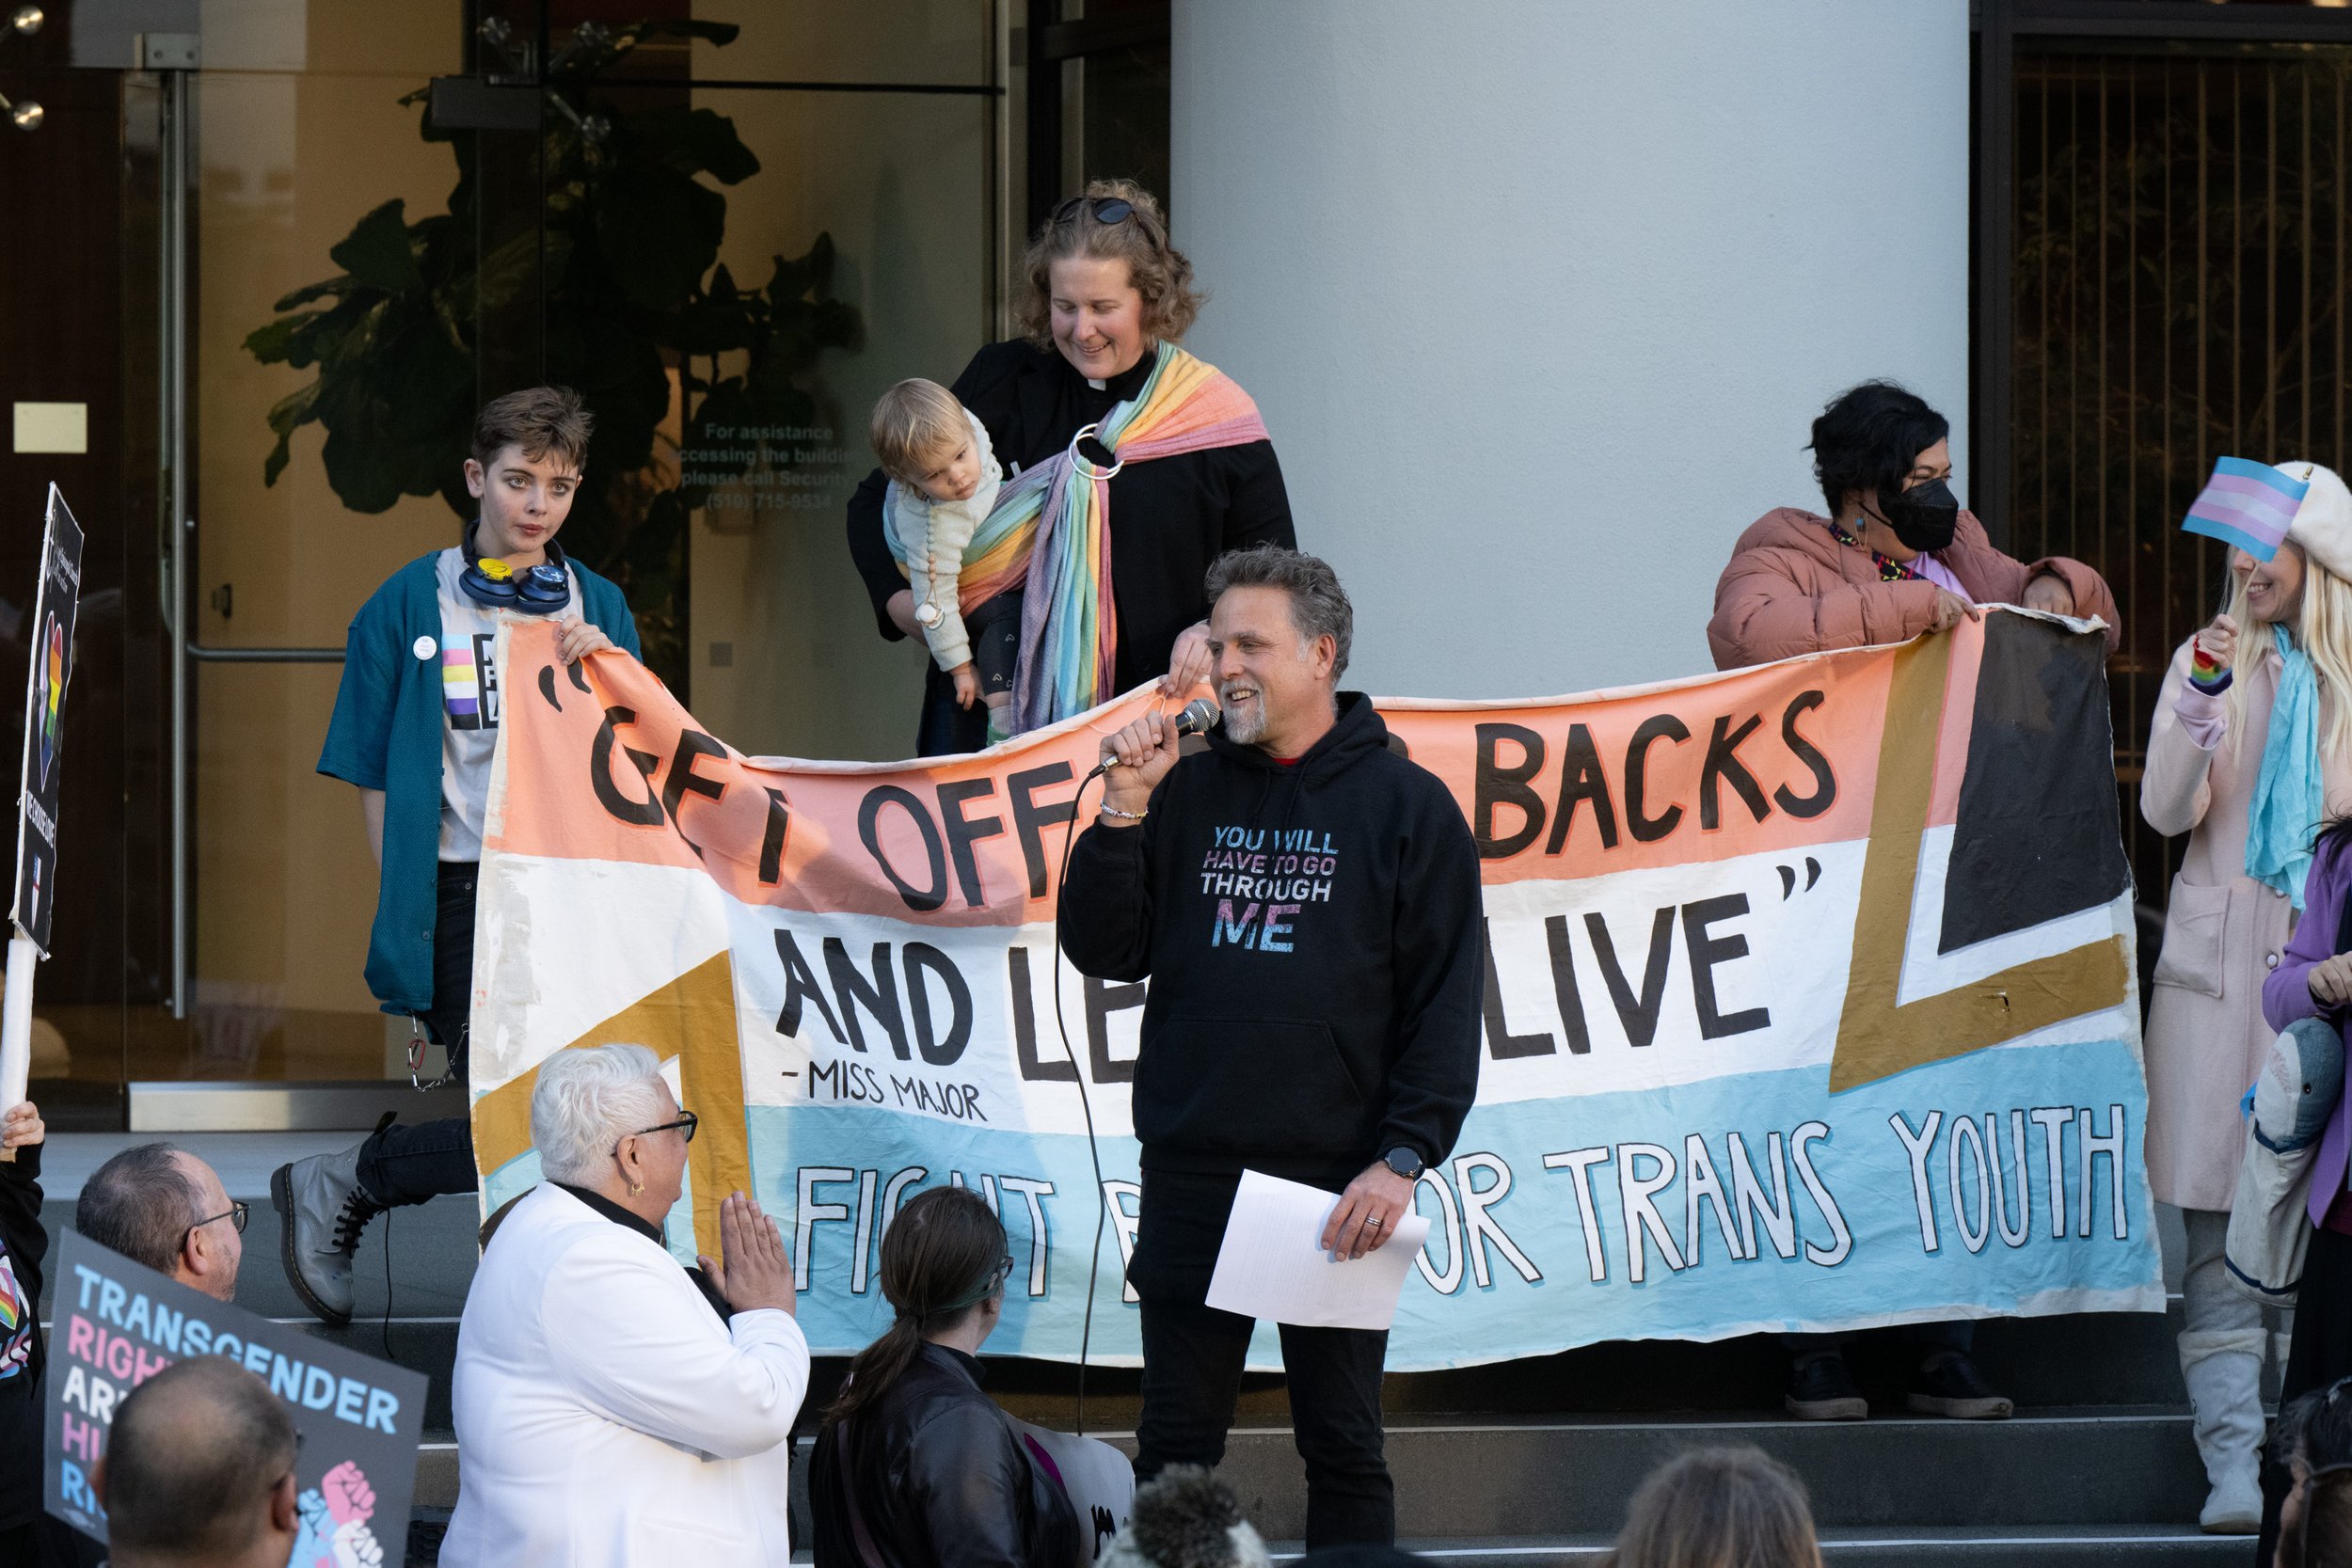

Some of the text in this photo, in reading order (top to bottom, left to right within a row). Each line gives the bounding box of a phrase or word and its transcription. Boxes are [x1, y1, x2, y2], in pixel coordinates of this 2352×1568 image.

[671, 446, 756, 467] ccessing
[761, 447, 789, 463] the
[705, 422, 834, 440] For assistance
[681, 469, 738, 487] please
[743, 470, 773, 486] call
[857, 760, 1079, 911] OFF
[1473, 689, 1837, 860] BACKS
[1202, 850, 1337, 876] HAVE TO GO
[1215, 826, 1339, 855] YOU WILL
[1200, 872, 1333, 903] THROUGH
[1212, 898, 1302, 953] ME
[773, 928, 973, 1067] AND
[1009, 946, 1146, 1085] LE
[897, 1073, 989, 1122] MAJOR
[794, 1165, 1056, 1297] FIT
[1411, 1150, 1544, 1294] OR
[1543, 1120, 1854, 1284] TRANS
[1888, 1103, 2127, 1254] YOUTH
[68, 1314, 173, 1386] RIGH
[74, 1264, 400, 1434] TRANSGENDER
[61, 1366, 126, 1425] AR
